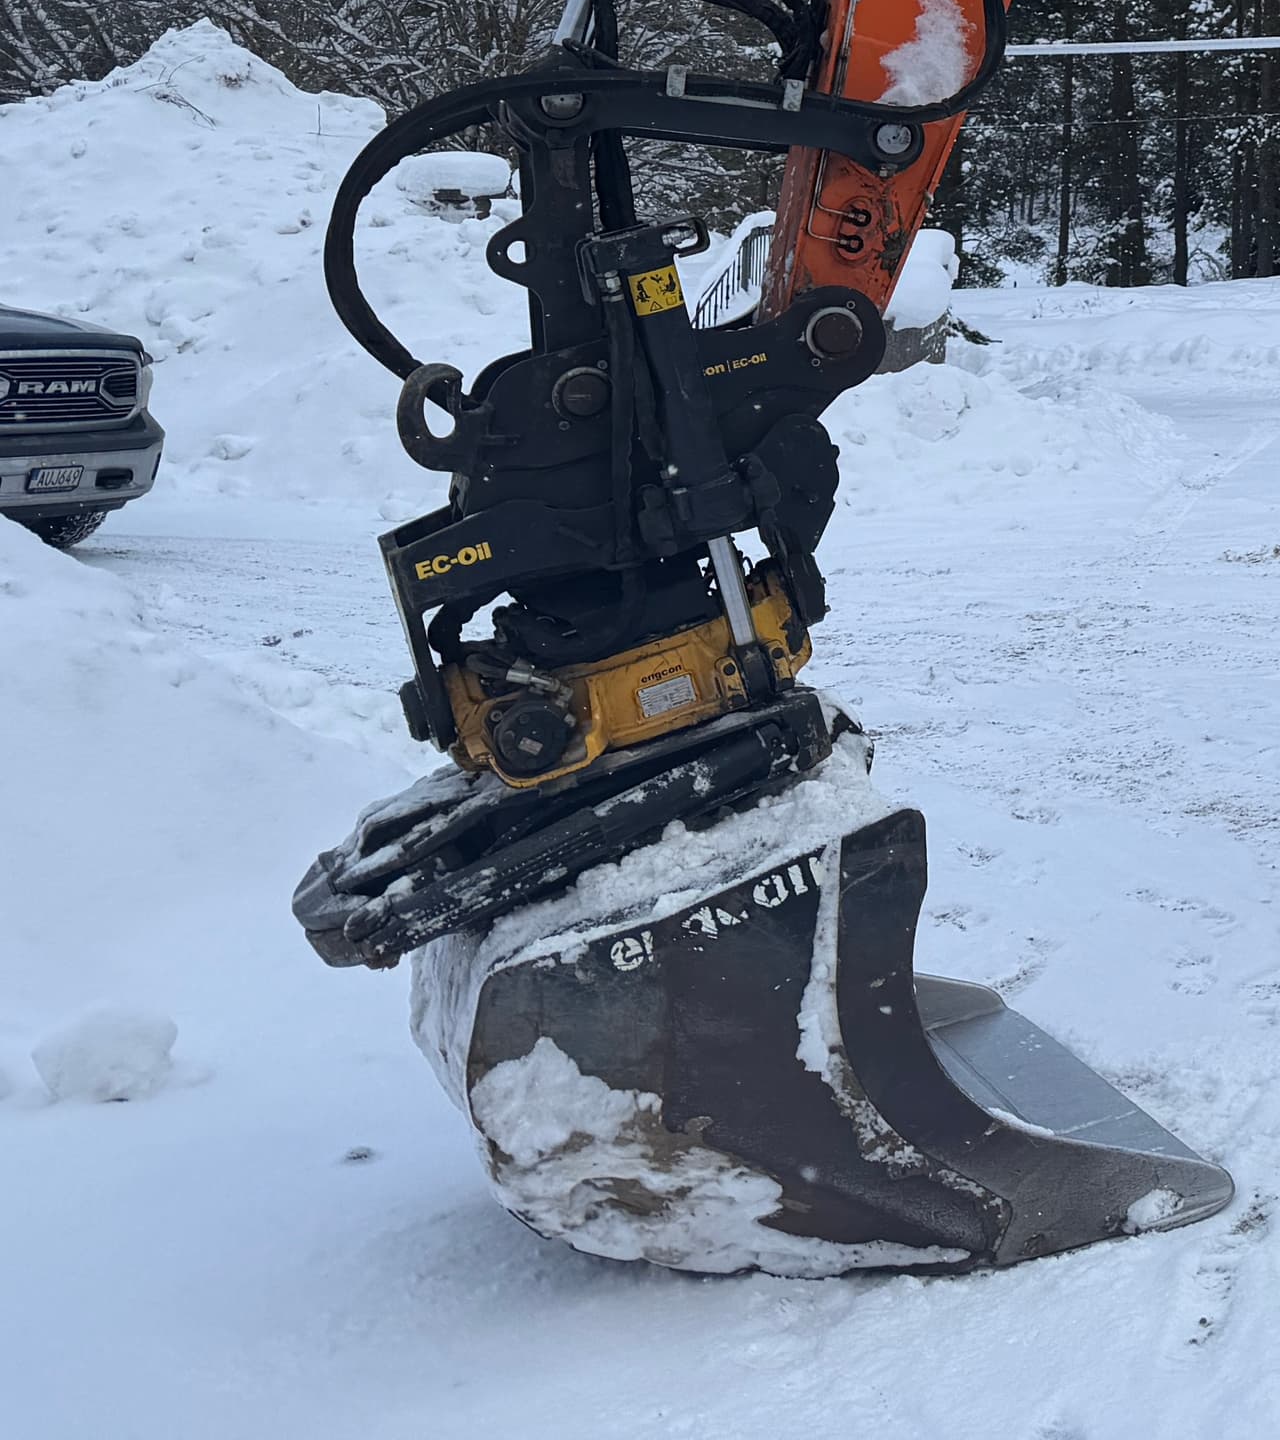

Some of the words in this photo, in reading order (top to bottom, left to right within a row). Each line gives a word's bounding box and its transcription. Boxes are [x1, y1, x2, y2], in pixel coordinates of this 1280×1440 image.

[17, 380, 97, 394] RAM
[36, 470, 81, 487] AUJ649
[641, 664, 682, 683] engcon
